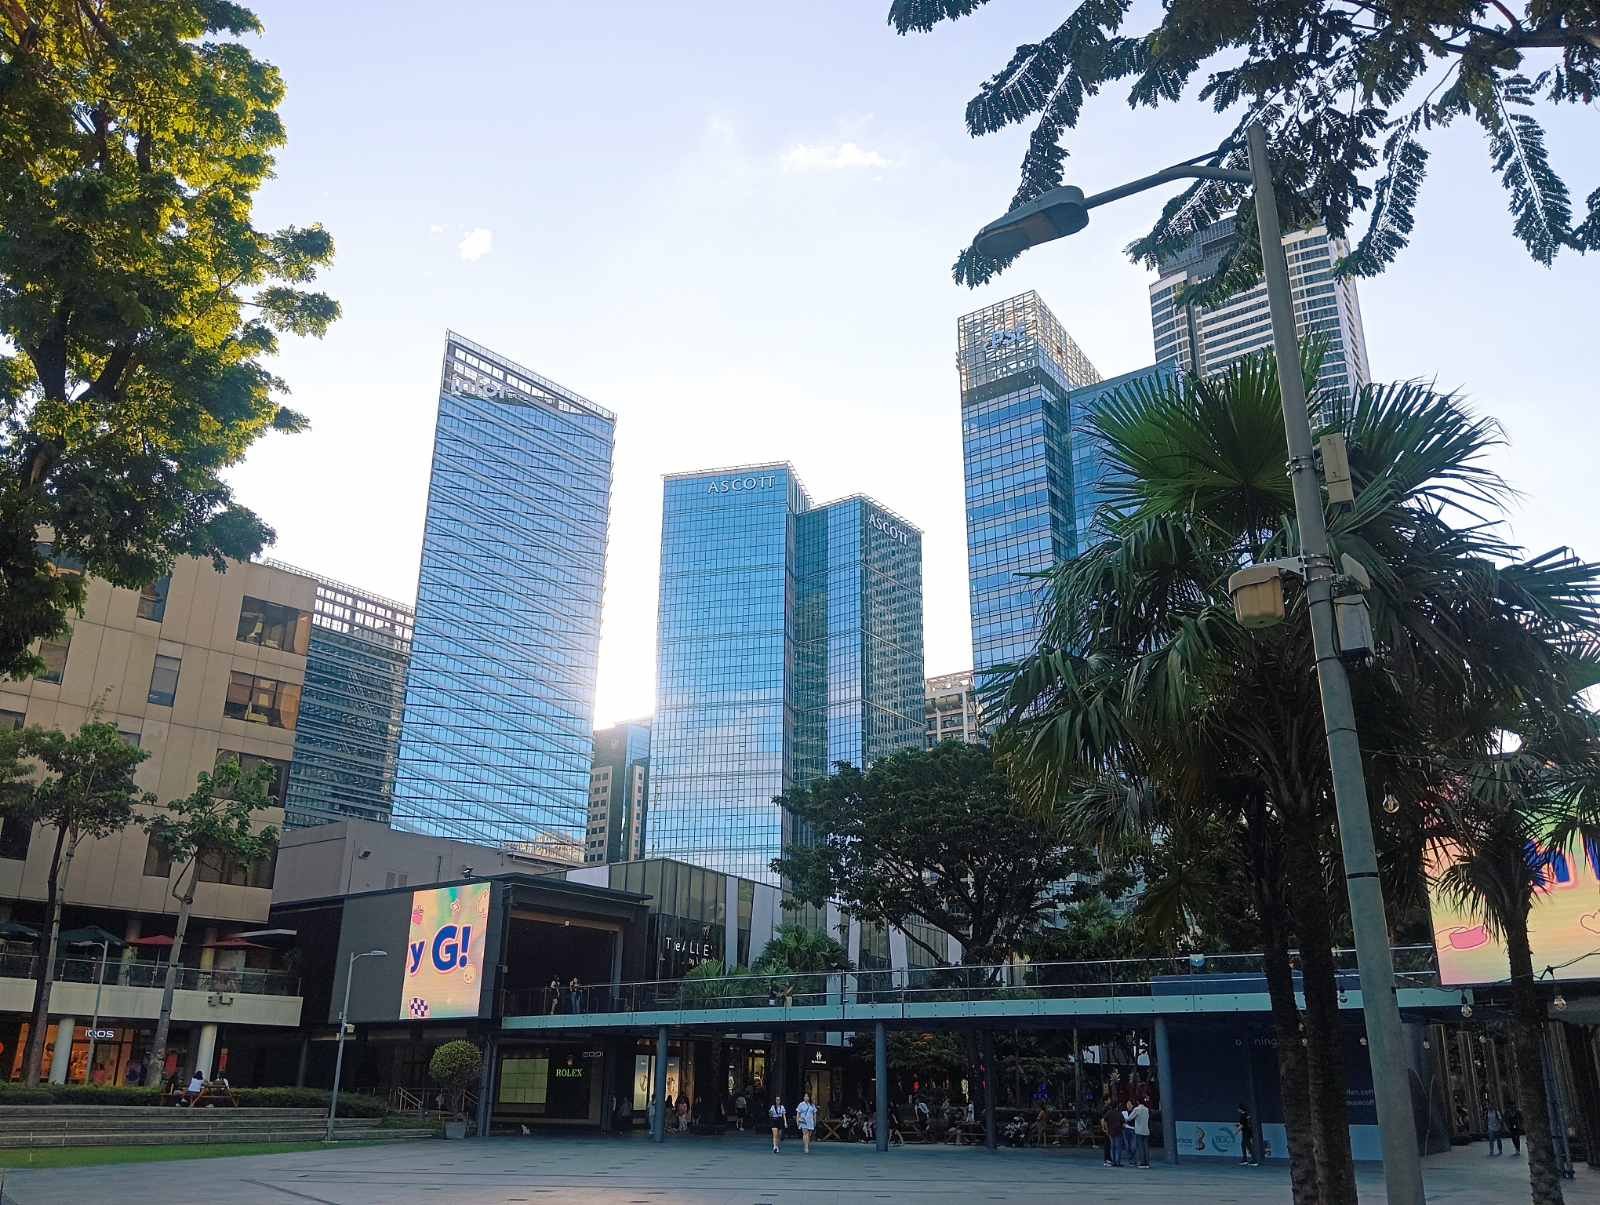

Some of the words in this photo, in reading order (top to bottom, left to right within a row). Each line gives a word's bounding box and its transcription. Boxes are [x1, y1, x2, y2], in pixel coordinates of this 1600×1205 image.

[708, 475, 776, 494] ASCOTT
[869, 513, 907, 545] ASCOTT
[431, 925, 472, 973] G!
[665, 937, 681, 952] Te
[682, 941, 713, 957] LLE
[556, 1068, 583, 1078] ROLEX
